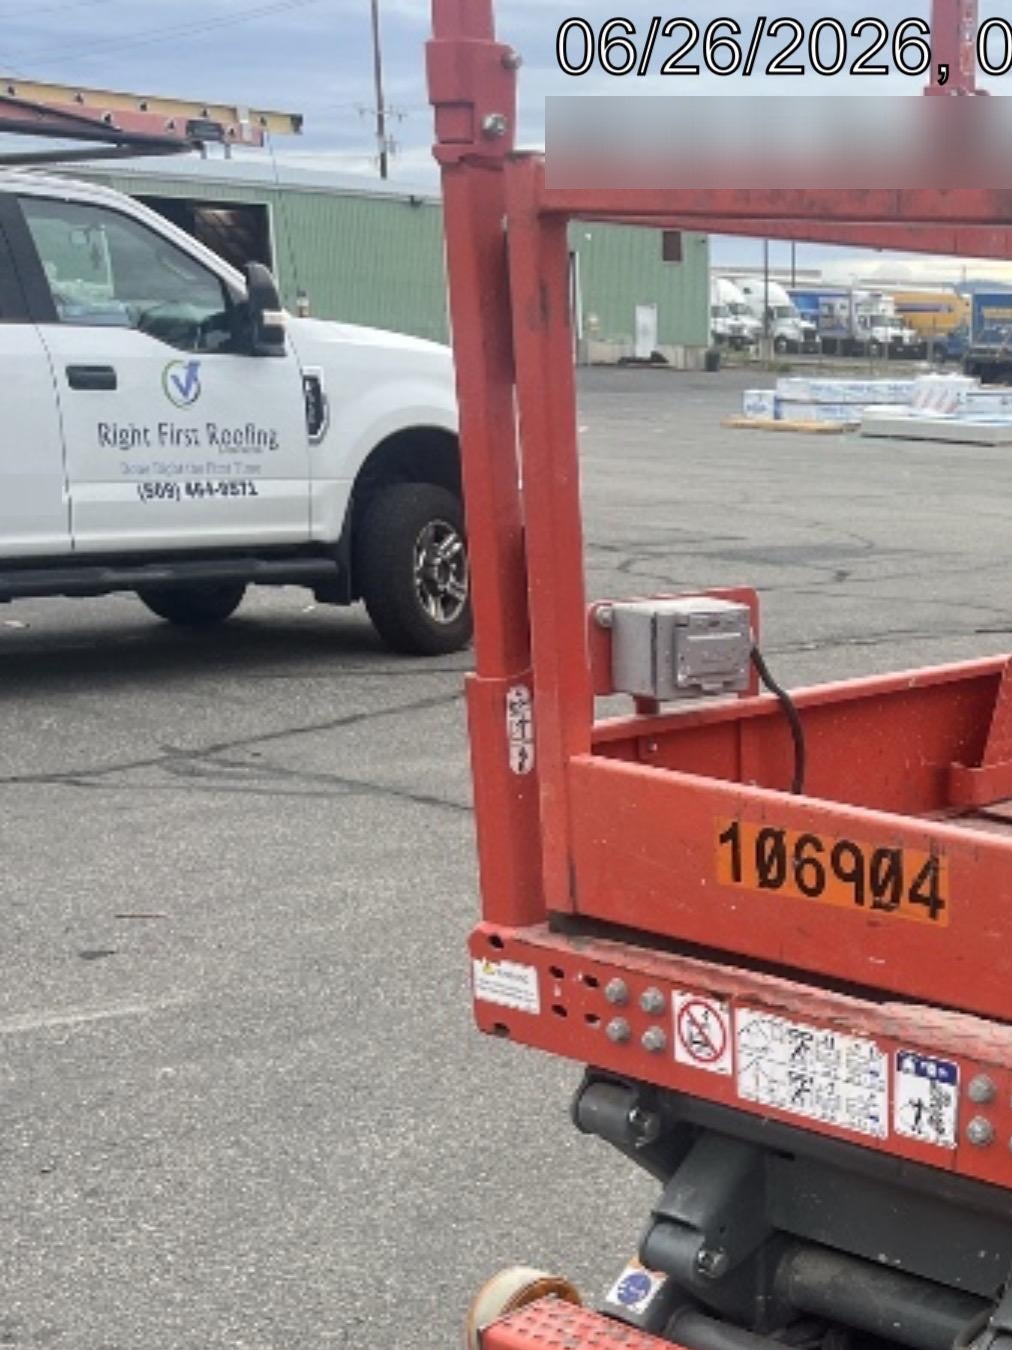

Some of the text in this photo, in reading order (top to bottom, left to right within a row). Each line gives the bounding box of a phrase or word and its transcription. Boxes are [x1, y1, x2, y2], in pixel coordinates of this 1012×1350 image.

[97, 421, 280, 451] Right First Roofing
[718, 820, 947, 921] 106904
